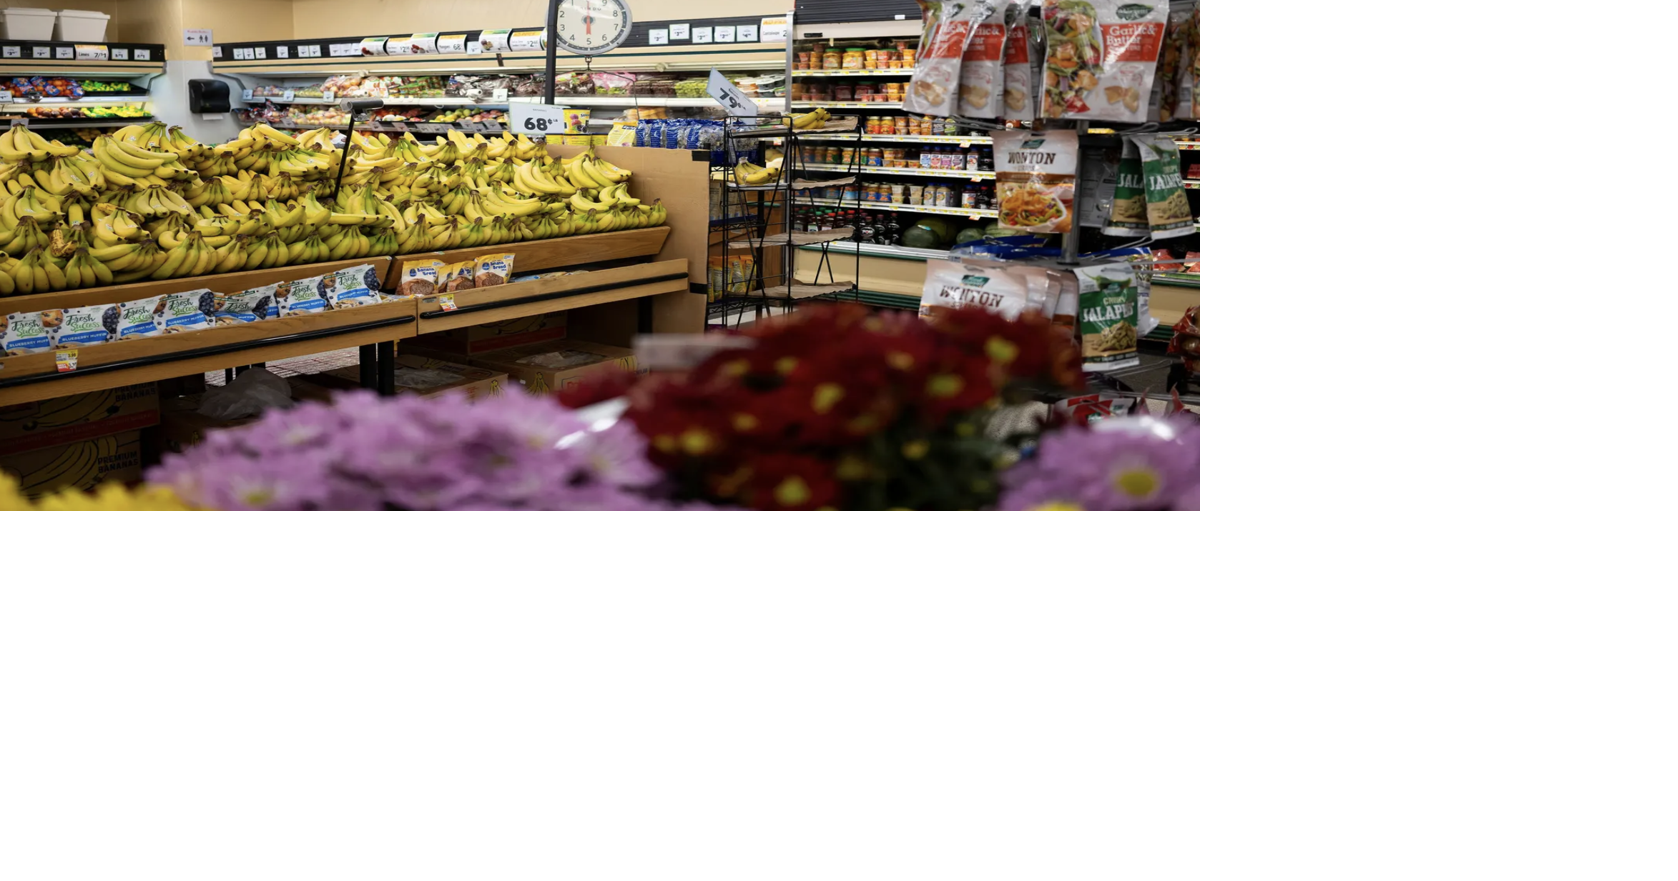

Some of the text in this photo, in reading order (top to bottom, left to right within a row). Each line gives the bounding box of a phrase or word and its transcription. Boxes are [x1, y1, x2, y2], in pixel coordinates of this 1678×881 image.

[559, 10, 565, 18] 2
[560, 23, 565, 31] 3
[613, 23, 619, 31] 7
[569, 34, 575, 42] 4
[601, 34, 607, 42] 6
[1007, 151, 1057, 165] WONTON
[168, 298, 194, 310] Fresh
[123, 306, 150, 320] Fresh
[11, 319, 40, 332] Fresh
[66, 313, 96, 327] Fresh
[70, 321, 101, 333] Success
[61, 334, 90, 342] BLUEBERRY
[115, 388, 156, 402] BANANAS
[97, 451, 137, 465] PREMIUM
[98, 458, 139, 474] BANANAS
